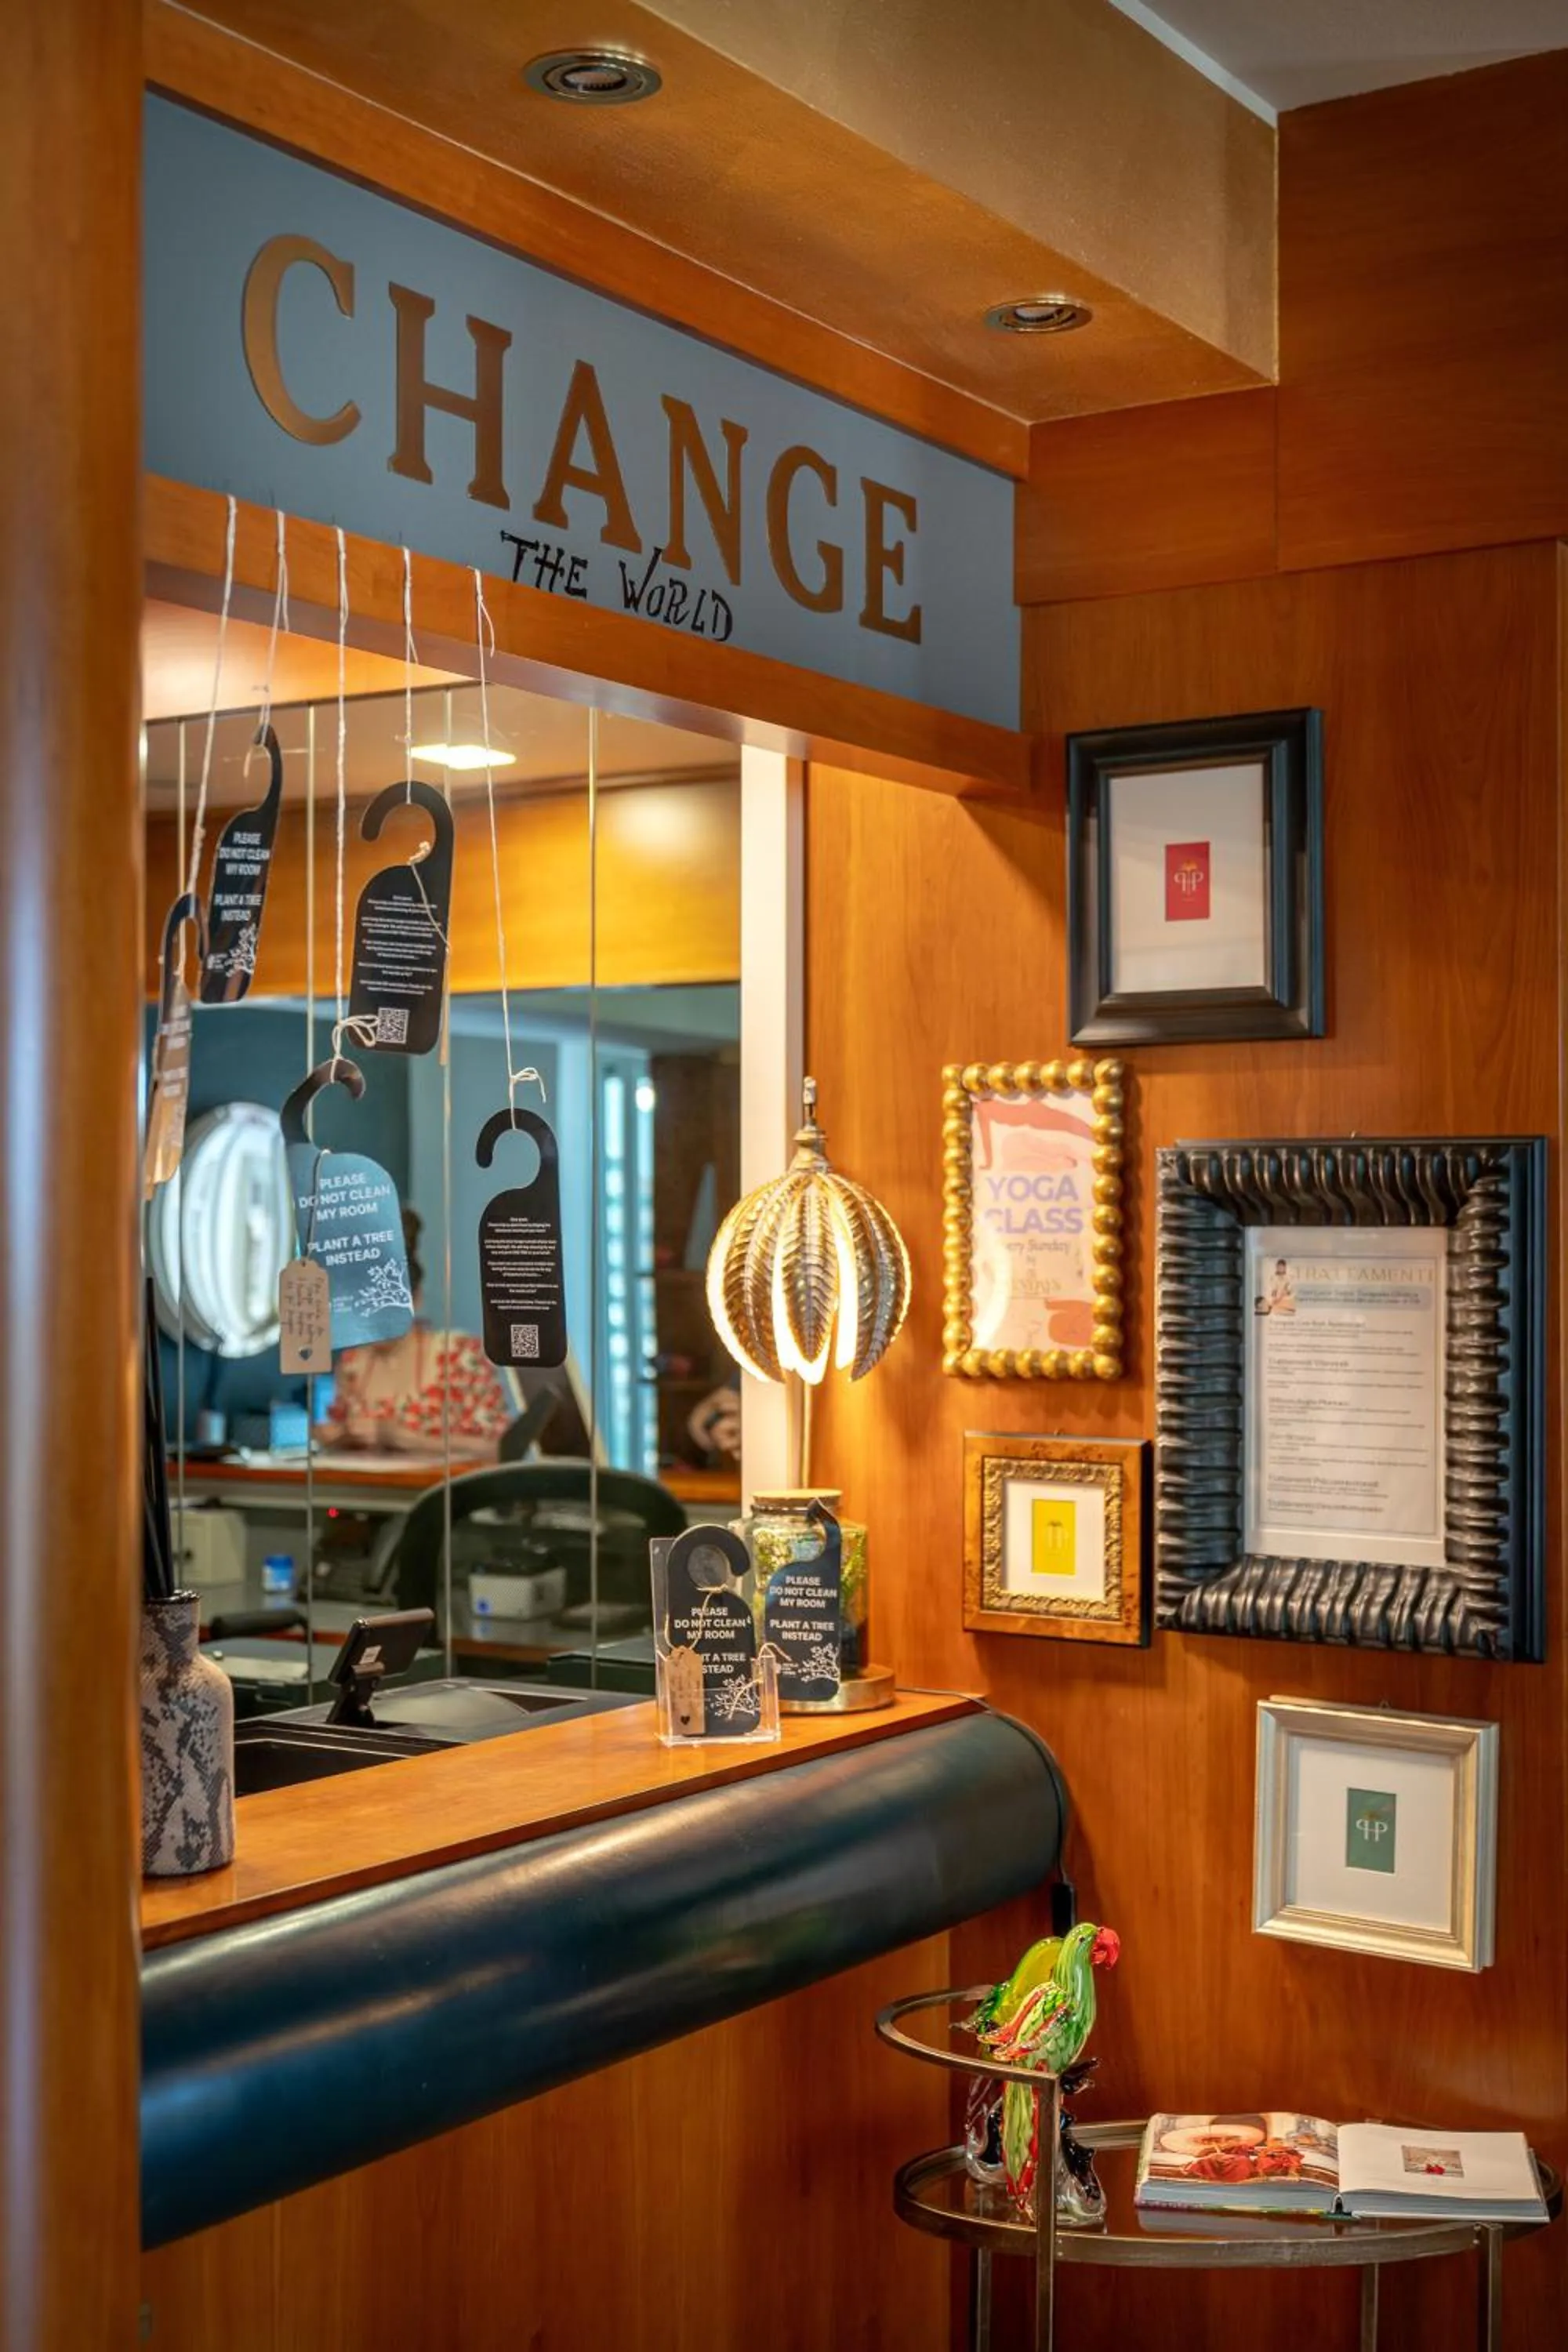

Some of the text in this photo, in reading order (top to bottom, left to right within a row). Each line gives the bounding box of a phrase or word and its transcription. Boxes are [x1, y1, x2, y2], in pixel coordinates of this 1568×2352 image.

[241, 234, 922, 644] CHANGE
[501, 530, 733, 643] THE WORLD
[233, 832, 262, 844] PLEASE
[220, 848, 270, 860] DO NOT CLEAN
[238, 864, 261, 876] ROOM
[319, 1173, 366, 1189] PLEASE
[986, 1174, 1079, 1202] YOGA
[299, 1185, 390, 1208] DO NOT CLEAN
[317, 1202, 378, 1221] MY ROOM
[307, 1230, 394, 1252] PLANT A TREE
[325, 1247, 381, 1266] INSTEAD
[786, 1575, 821, 1586] PLEASE
[769, 1586, 837, 1598] DO NOT CLEAN
[779, 1597, 826, 1609] MY ROOM
[691, 1607, 728, 1617] PLEASE
[673, 1619, 746, 1628] DO NOT CLEAN
[769, 1619, 835, 1631] PLANT A TREE
[687, 1631, 735, 1639] MY ROOM
[782, 1631, 823, 1641] INSTEAD
[713, 1653, 720, 1661] A
[722, 1653, 746, 1662] TREE
[702, 1664, 735, 1674] STEAD
